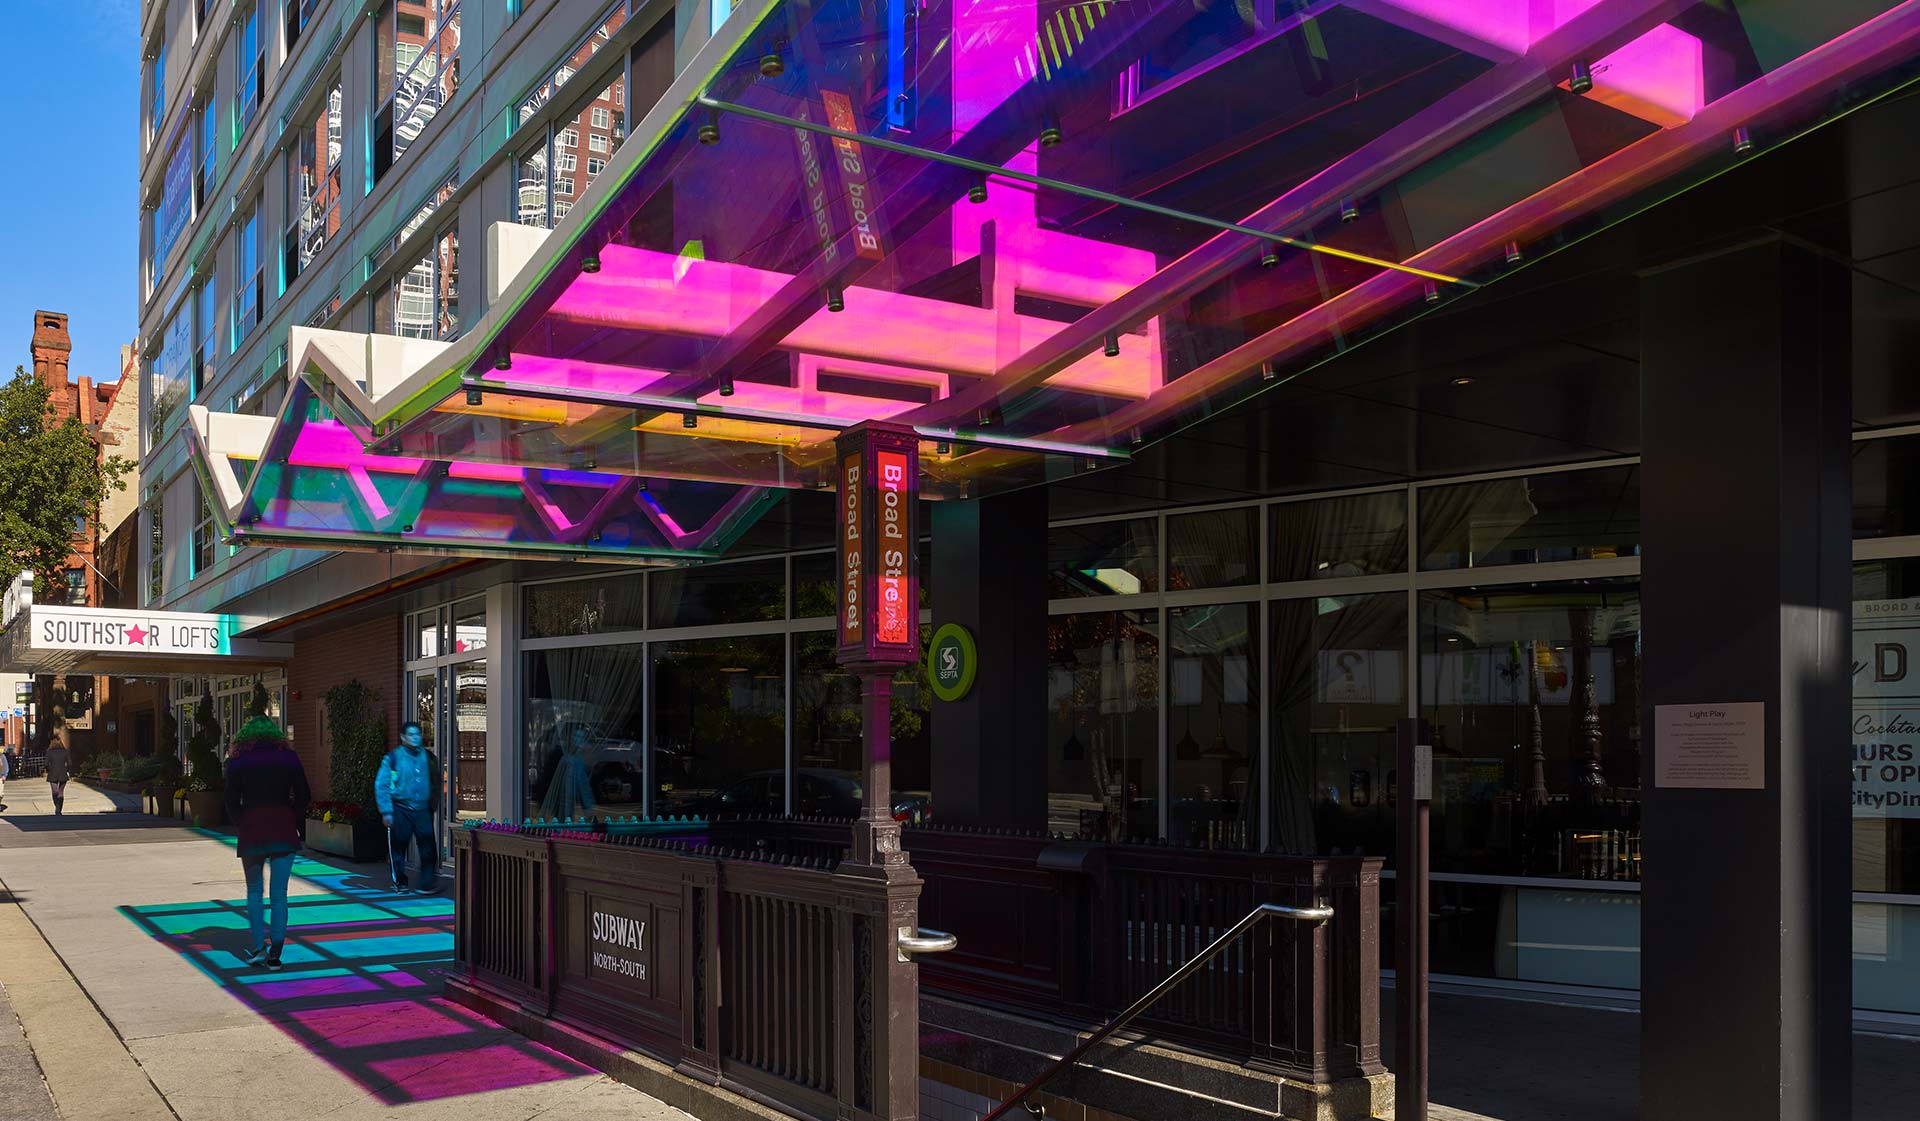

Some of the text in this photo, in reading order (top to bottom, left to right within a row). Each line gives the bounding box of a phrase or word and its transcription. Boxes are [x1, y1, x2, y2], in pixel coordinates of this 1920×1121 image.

[884, 463, 903, 539] Broad
[847, 465, 861, 630] Broad Street
[171, 625, 220, 650] LOFTS
[940, 670, 959, 680] SEPTA
[1689, 709, 1726, 720] Light Play
[1880, 765, 1920, 782] OP
[593, 911, 646, 951] SUBWAY
[593, 951, 646, 981] NORTH-SOUTH
